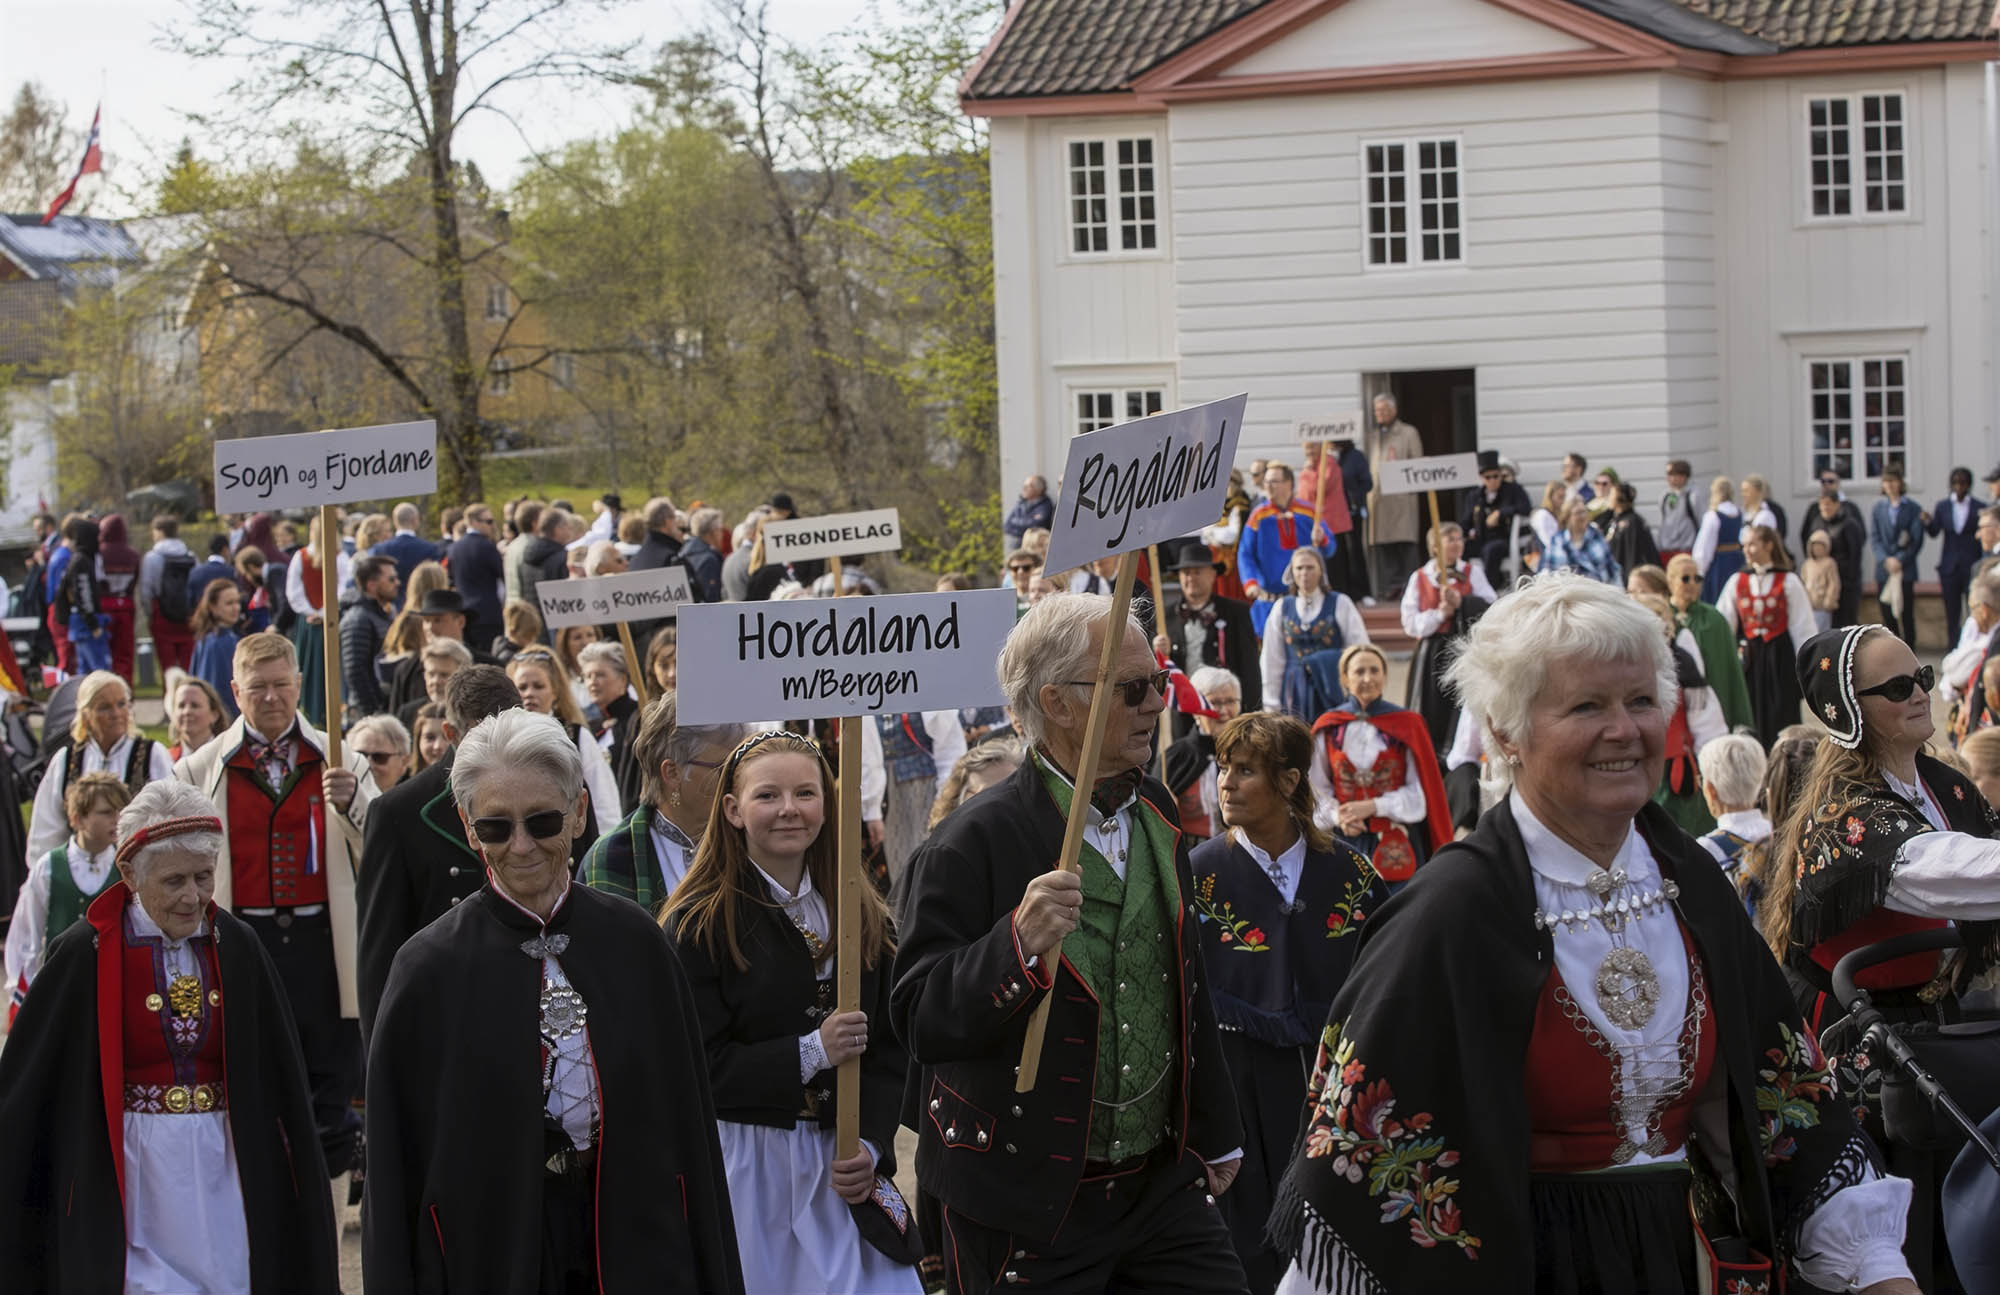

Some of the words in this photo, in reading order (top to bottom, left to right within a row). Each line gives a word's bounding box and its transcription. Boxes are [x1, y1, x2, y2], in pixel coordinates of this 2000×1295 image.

[220, 463, 289, 498] Sogn
[298, 469, 318, 489] og
[326, 449, 433, 491] Fjordane
[1071, 419, 1227, 549] Rogaland
[1401, 466, 1458, 484] Troms
[771, 522, 894, 549] TRØNDELAG
[543, 593, 586, 616] Møre
[592, 597, 611, 615] og
[612, 584, 690, 608] Romsdal
[738, 601, 961, 661] Hordaland
[782, 668, 919, 710] m/Bergen
